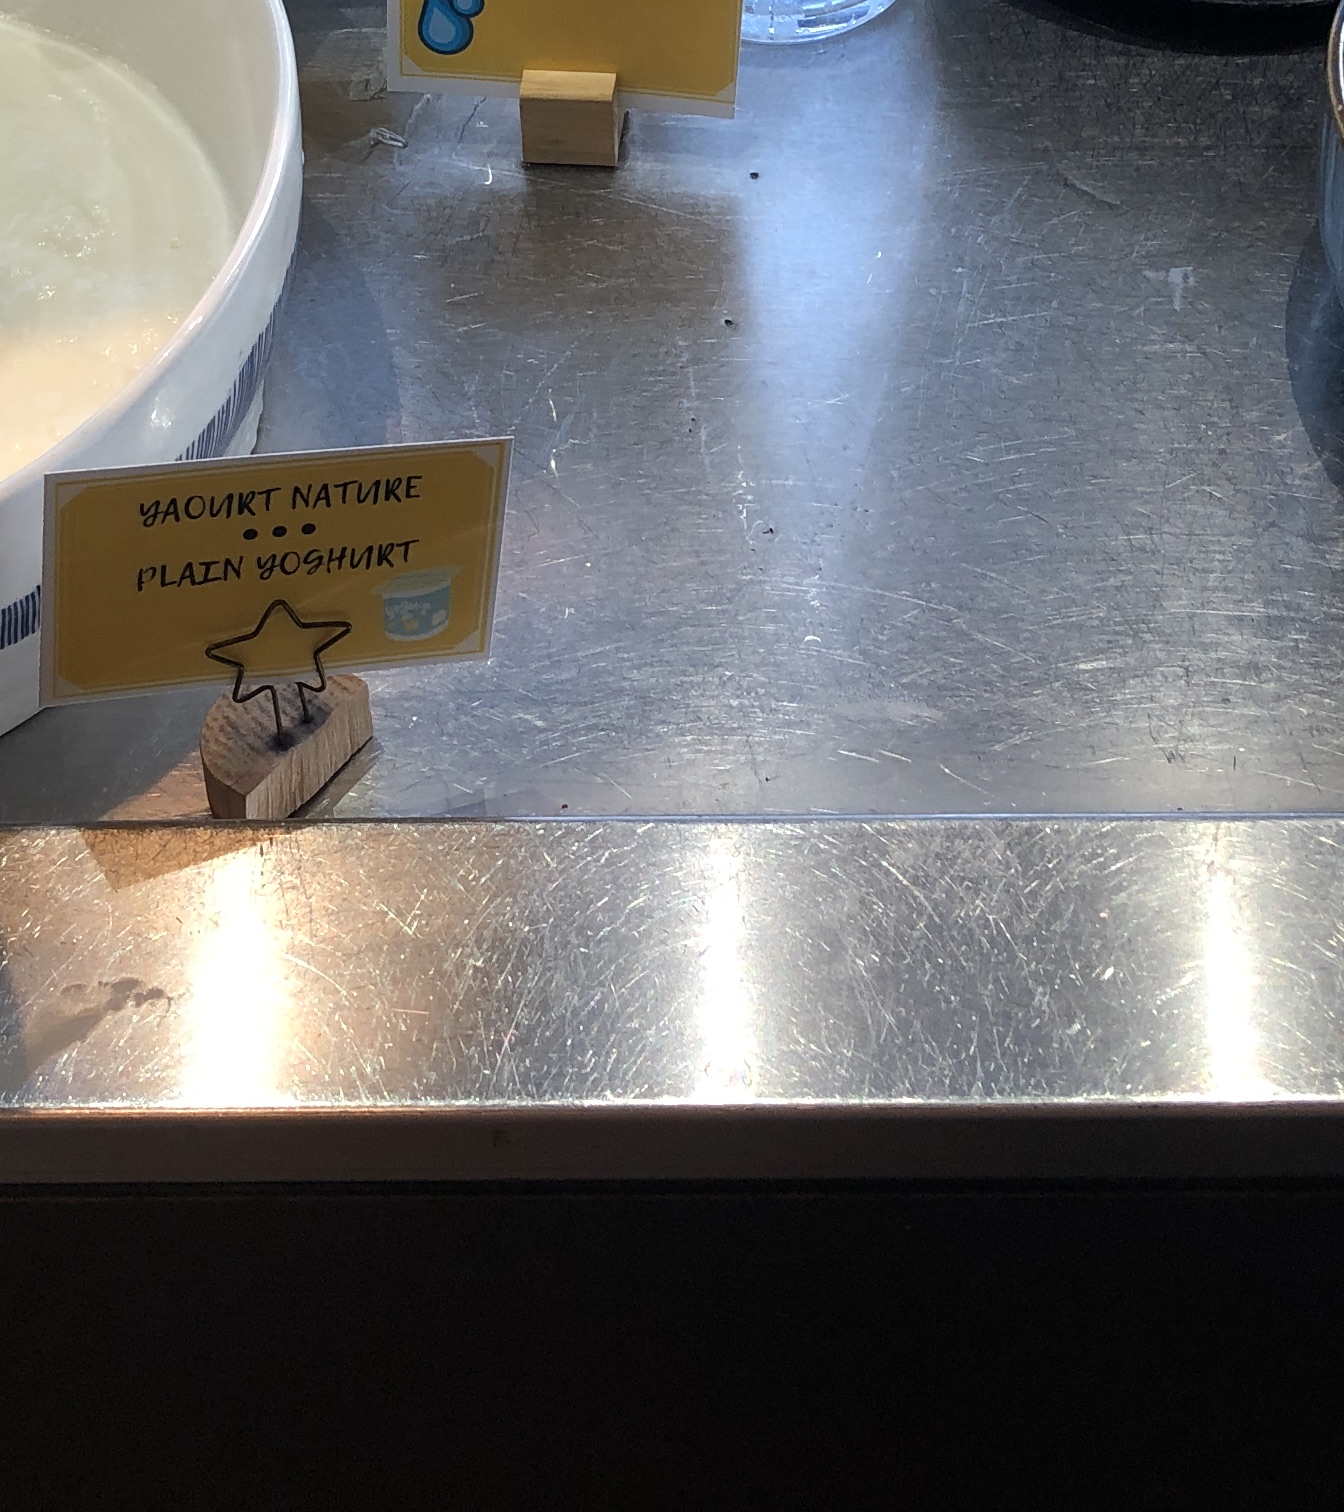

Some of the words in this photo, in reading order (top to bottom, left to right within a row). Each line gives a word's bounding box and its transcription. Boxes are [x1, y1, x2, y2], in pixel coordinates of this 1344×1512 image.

[138, 486, 283, 528] YAOURT
[291, 475, 423, 509] NATURE
[136, 555, 244, 592] PLAIN
